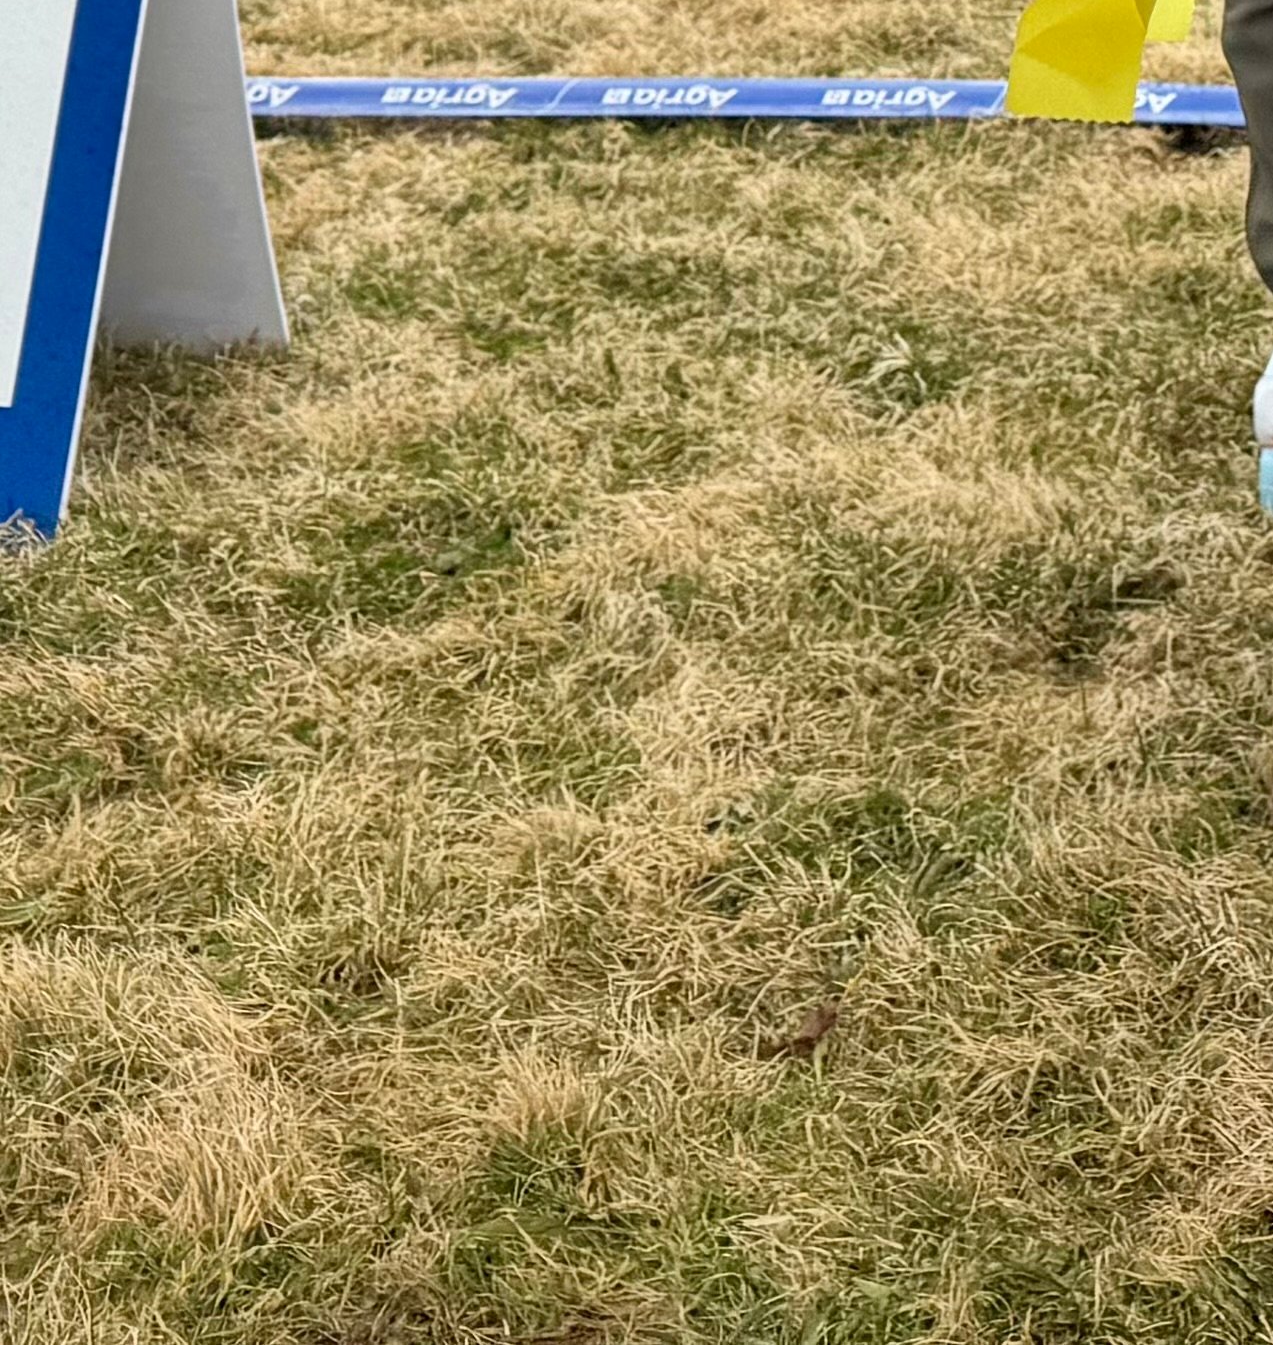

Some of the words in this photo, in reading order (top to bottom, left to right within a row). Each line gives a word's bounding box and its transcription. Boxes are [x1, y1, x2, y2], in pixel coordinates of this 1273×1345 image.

[412, 83, 518, 109] Agria
[632, 85, 738, 109] Agria
[848, 86, 956, 110] Agria
